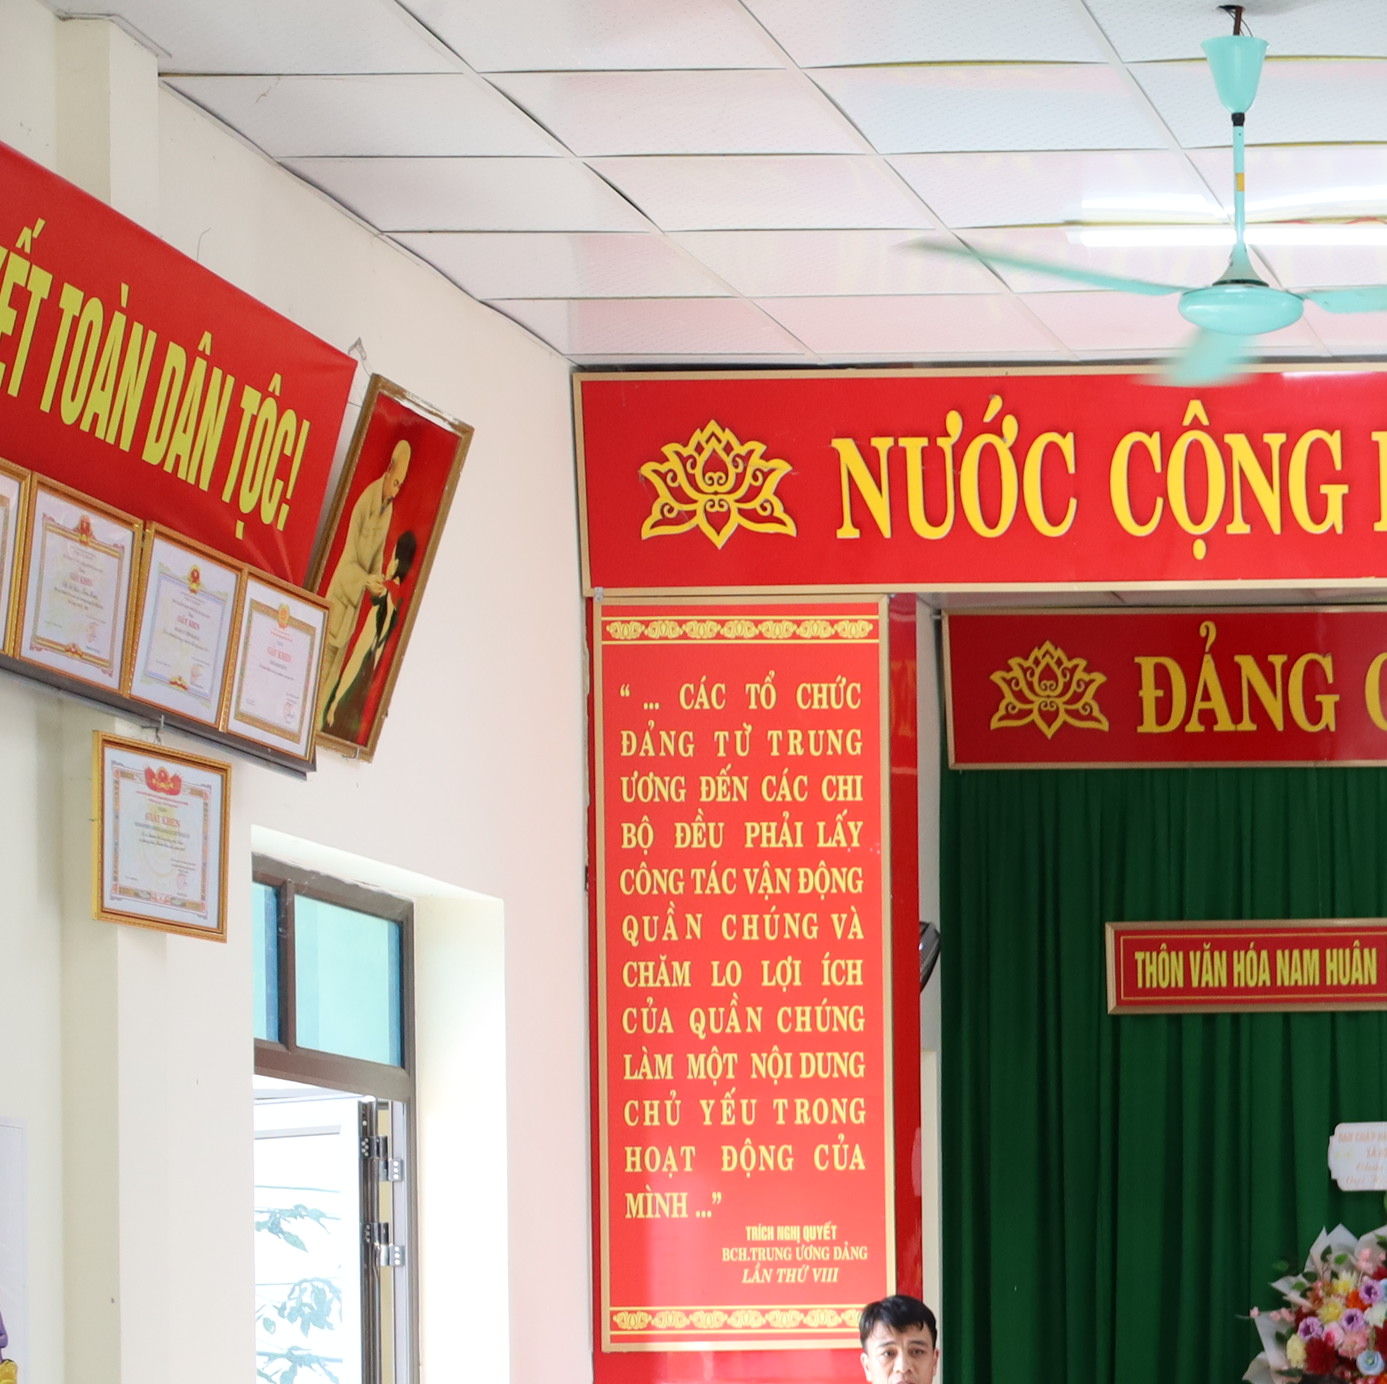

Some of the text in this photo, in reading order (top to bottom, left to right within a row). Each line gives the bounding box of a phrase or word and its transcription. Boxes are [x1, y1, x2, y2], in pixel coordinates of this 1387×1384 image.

[0, 218, 311, 540] ẾT TOÀN DÂN TỘC!
[831, 395, 1077, 540] NƯỚC
[1110, 400, 1349, 560] CỘNG
[679, 675, 726, 710] CÁC
[745, 670, 776, 710] TỔ
[796, 675, 861, 709] CHỨC
[1134, 621, 1340, 733] ĐẢNG
[621, 720, 863, 757] ĐẢNG TỪ TRUNG
[621, 763, 863, 803] ƯƠNG ĐẾN CÁC CHI
[621, 808, 863, 855] BỘ ĐỀU PHẢI LẤY
[1135, 940, 1377, 988] THÔN VĂN HÓA NAM HUÂN
[722, 1247, 792, 1261] BCH.TRUNG
[795, 1244, 830, 1261] ƯƠNG
[746, 1221, 837, 1244] TRÍCH NGHỊ QUYẾT
[776, 1264, 810, 1283] THỨ
[812, 1267, 839, 1283] VIII
